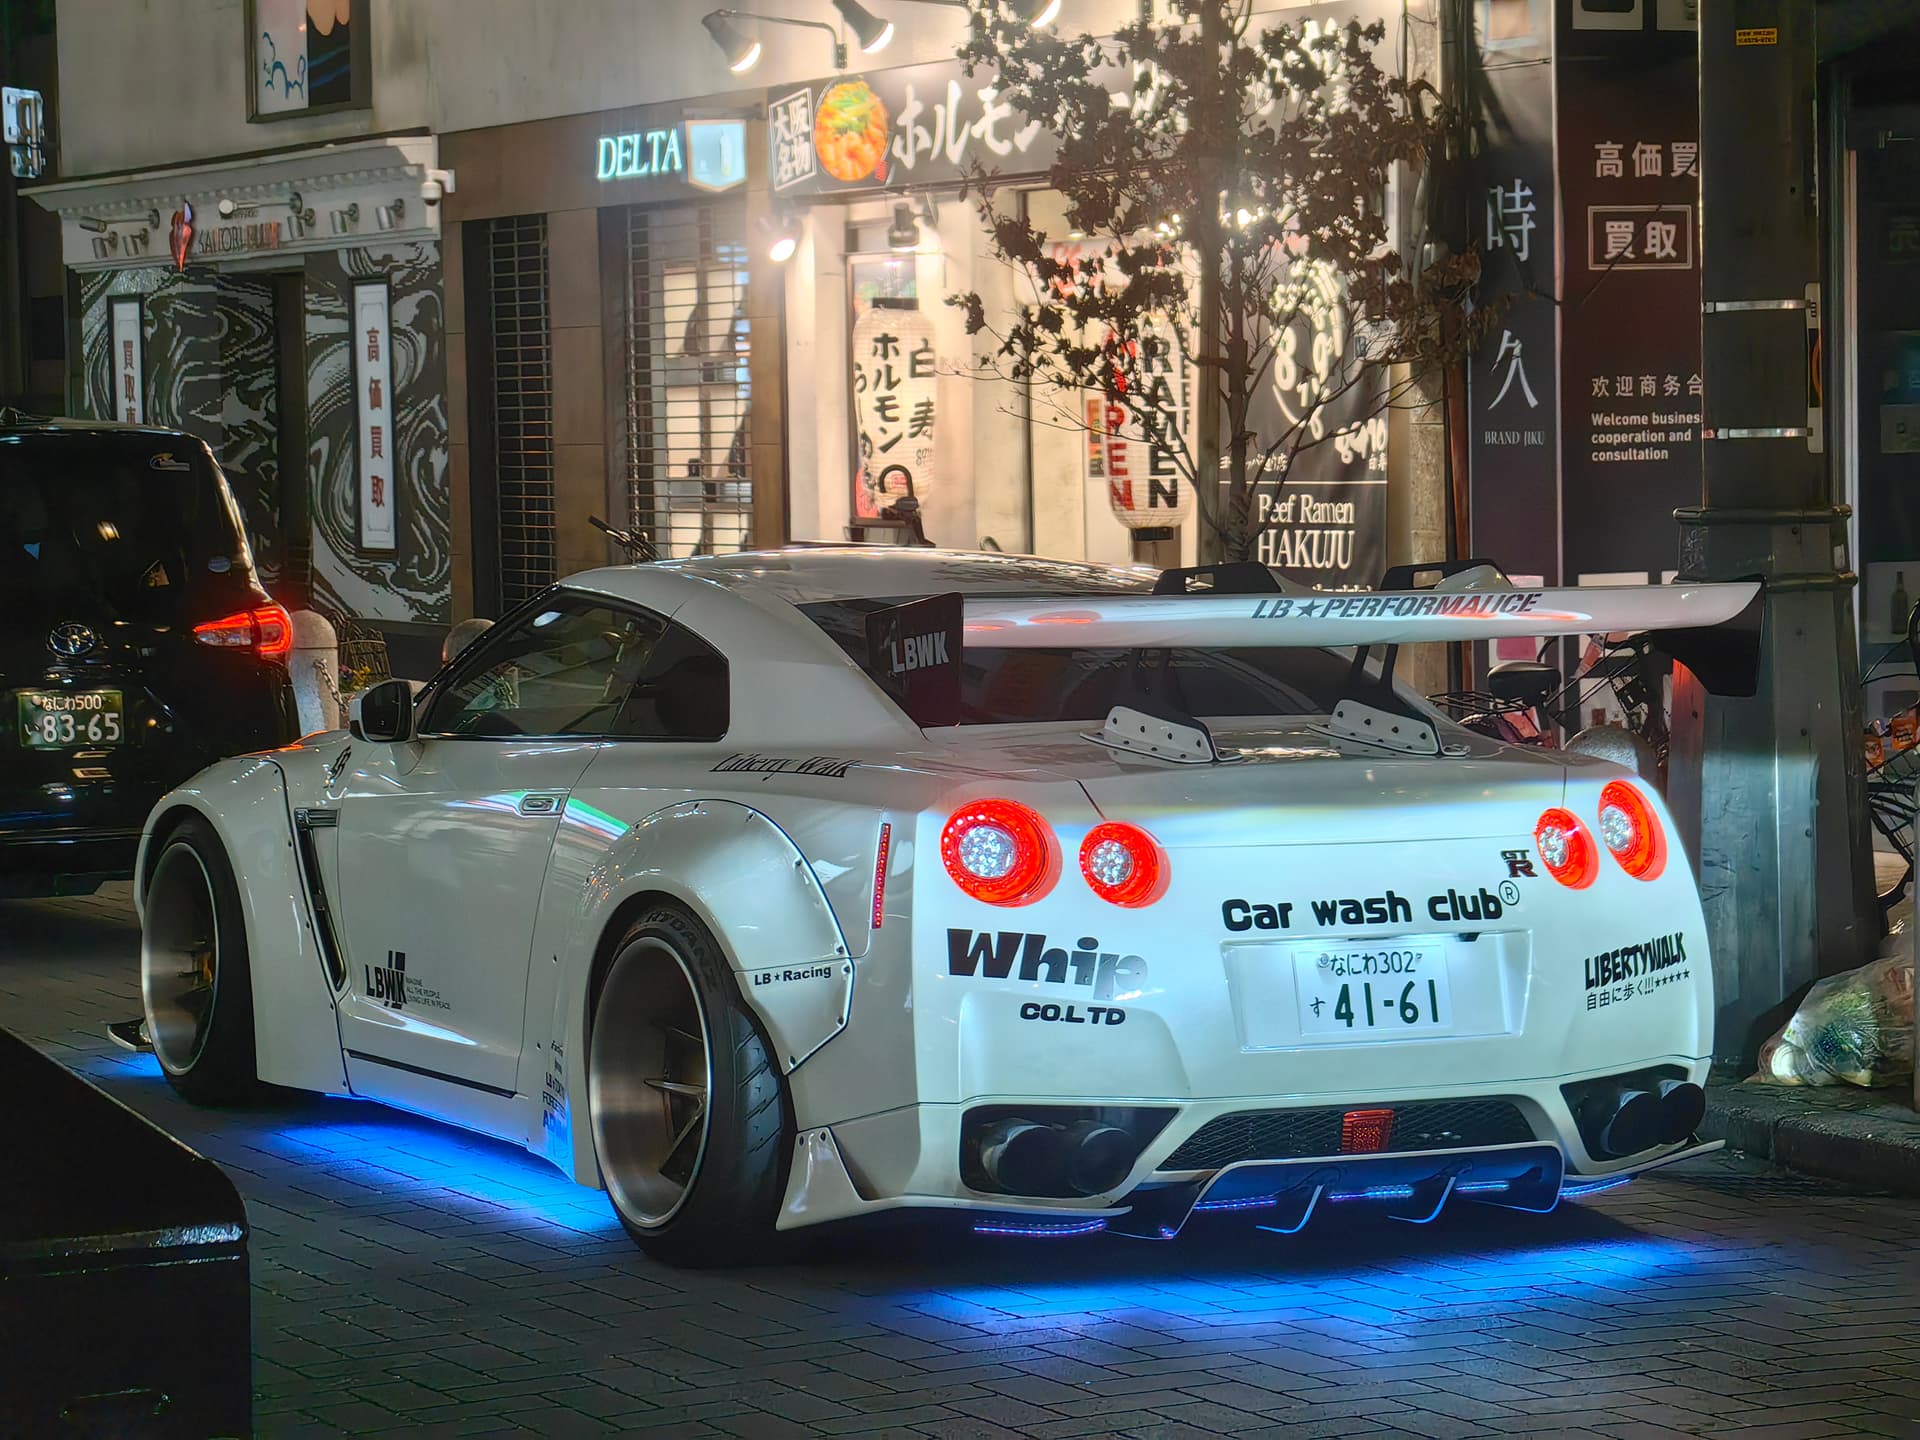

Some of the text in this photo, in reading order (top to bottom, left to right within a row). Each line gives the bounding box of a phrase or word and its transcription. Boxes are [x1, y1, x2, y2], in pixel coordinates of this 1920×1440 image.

[597, 128, 682, 179] DELTA
[777, 136, 813, 182] 名物
[1594, 140, 1698, 178] 高価買
[1604, 220, 1677, 260] 買取
[872, 333, 903, 454] ホルモン
[1592, 411, 1703, 425] Welcome busines
[1592, 429, 1691, 445] cooperation and
[1485, 431, 1544, 446] BRAND JIKU
[1592, 448, 1668, 461] consultation
[1300, 494, 1354, 524] Ramen
[1258, 529, 1355, 569] HAKUJU
[891, 631, 949, 672] LBWK
[43, 713, 119, 742] 83-65
[1222, 899, 1293, 931] Car
[1311, 891, 1412, 926] wash
[754, 967, 832, 985] LB Racing
[947, 928, 1147, 1000] Whip
[1331, 951, 1417, 976] なにわ302
[1584, 931, 1687, 991] LIBERTYWALK
[365, 963, 407, 1004] LBWK
[1310, 980, 1439, 1027] す 41-61
[1020, 1003, 1126, 1025] CO.LTD
